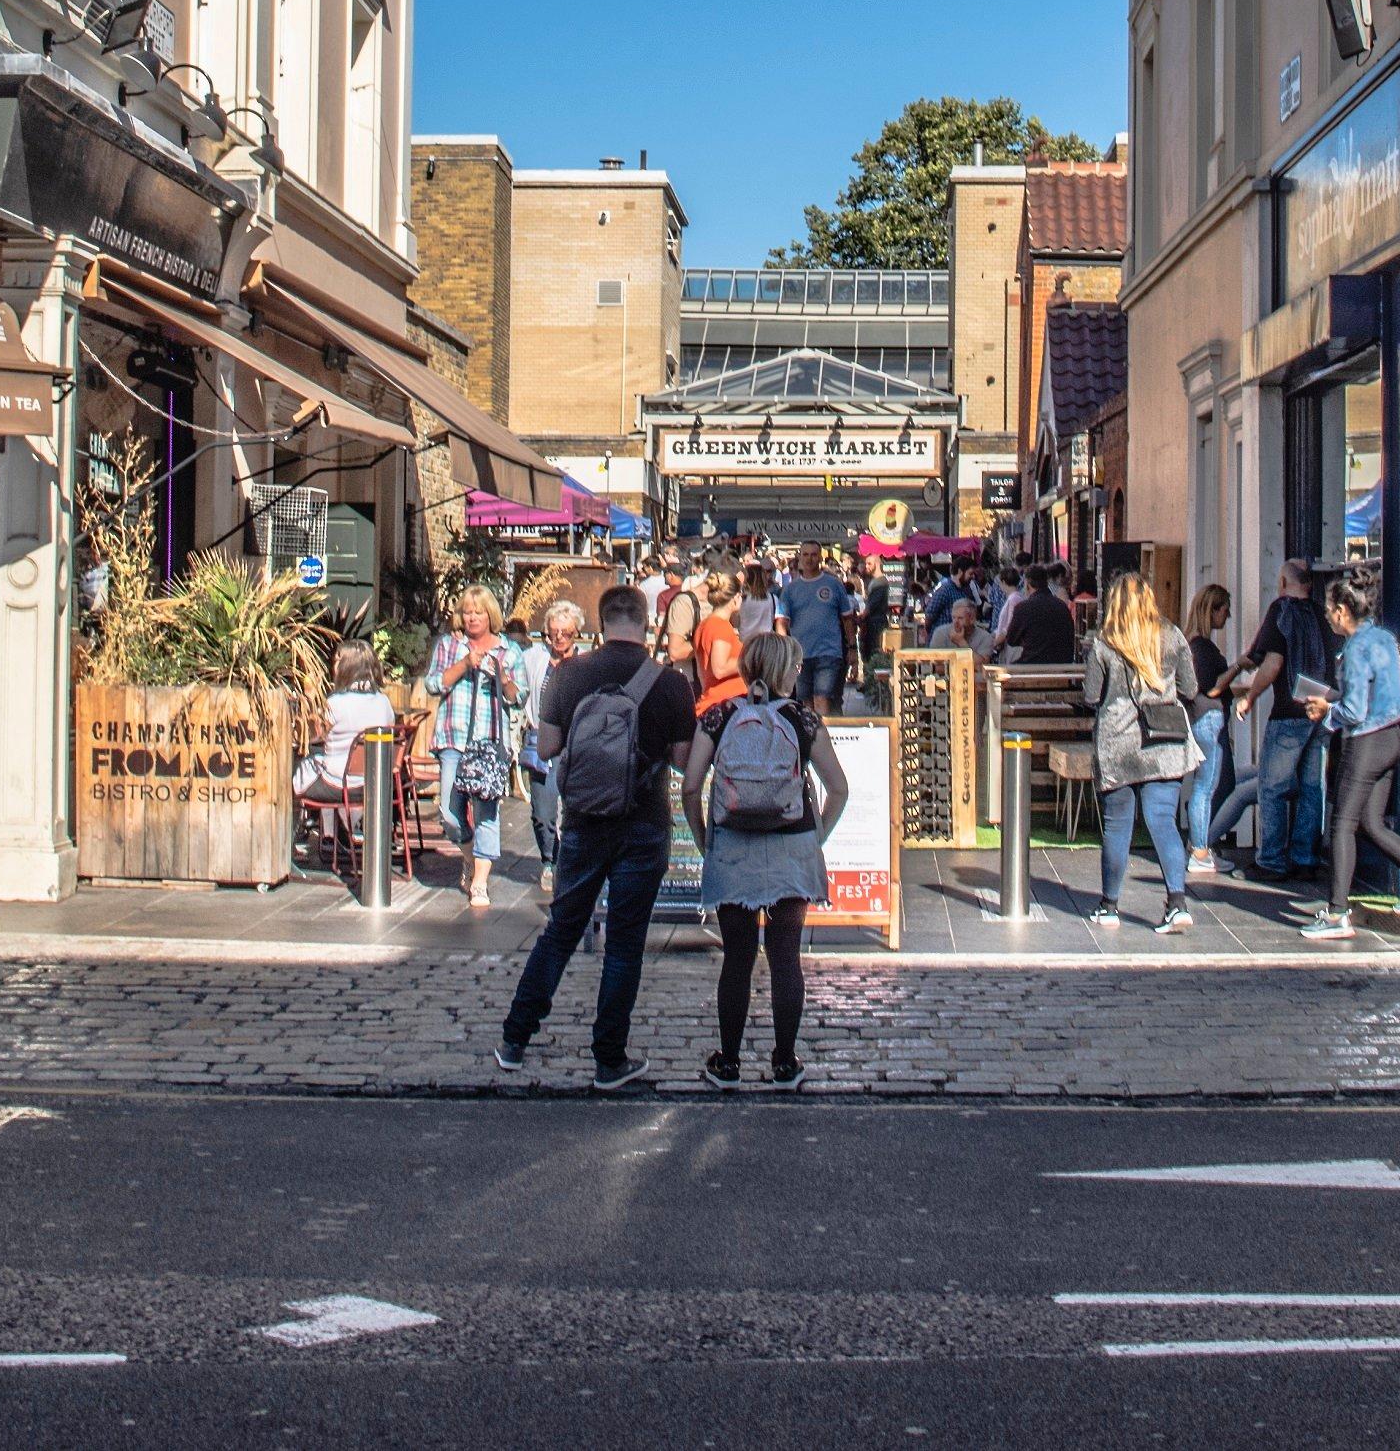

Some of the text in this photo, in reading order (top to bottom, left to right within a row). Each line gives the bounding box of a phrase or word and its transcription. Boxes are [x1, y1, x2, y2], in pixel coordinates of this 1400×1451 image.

[1299, 182, 1341, 270] sophia
[1360, 138, 1399, 215] matt
[88, 216, 131, 252] ARTISAN
[129, 237, 166, 268] FRENCH
[164, 252, 194, 284] BISTRO
[201, 271, 219, 294] DELI
[15, 397, 41, 411] TEA
[672, 441, 928, 455] GREENWICH MARKET
[990, 478, 1013, 486] TAILOR
[962, 707, 971, 805] Greenwich
[93, 784, 257, 804] BISTRO & SHOP
[837, 885, 871, 898] FEST
[870, 898, 882, 911] 18
